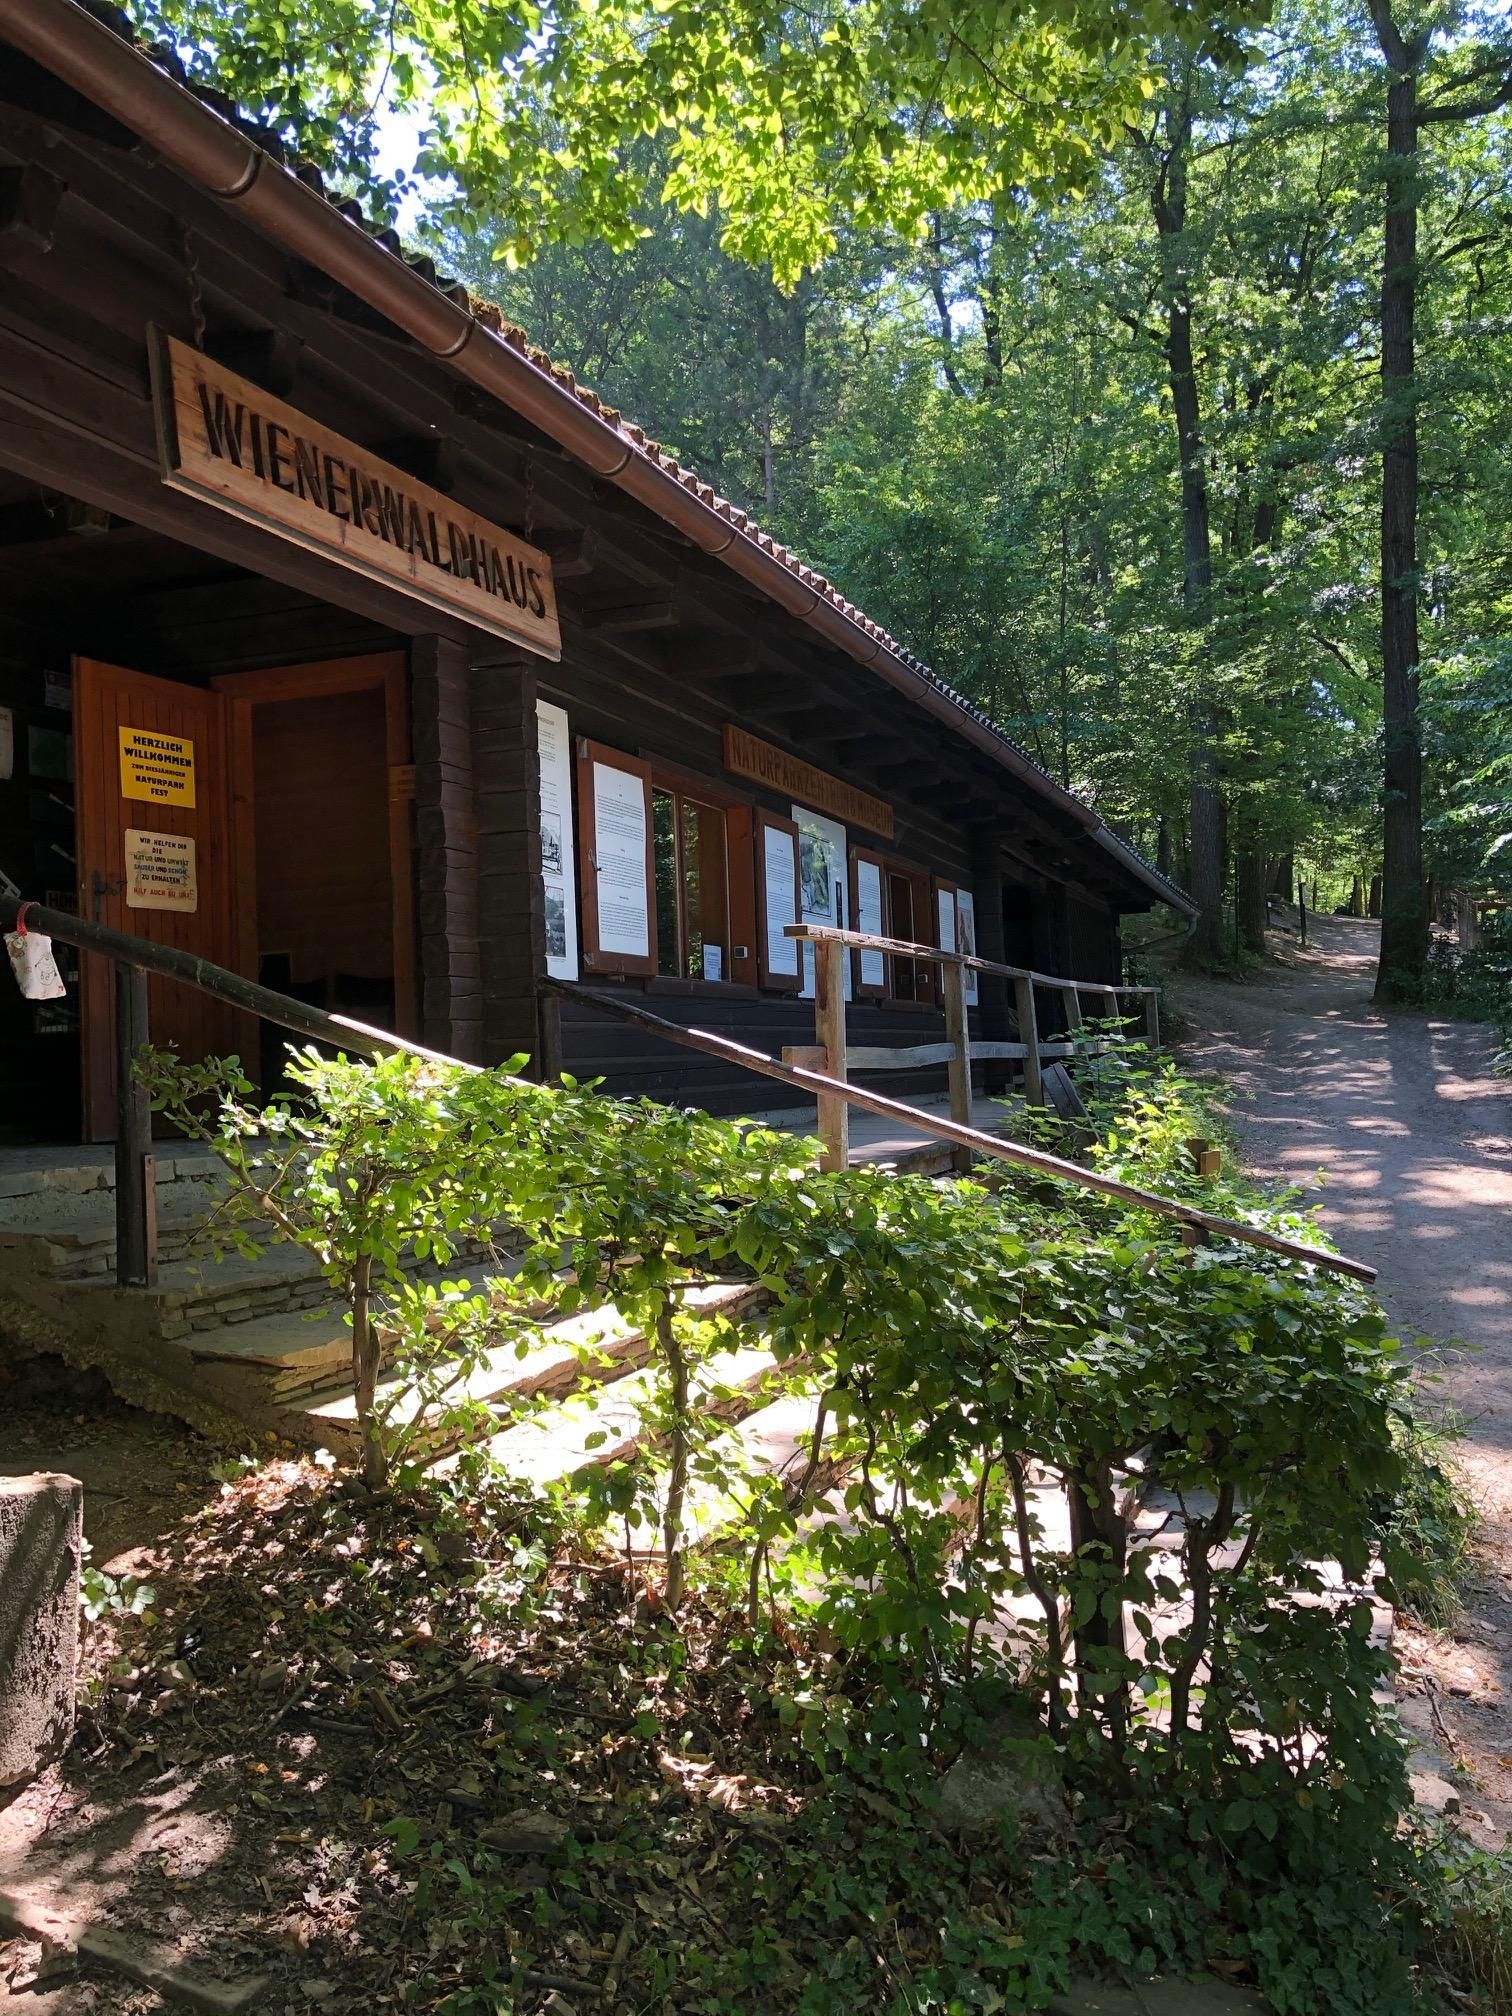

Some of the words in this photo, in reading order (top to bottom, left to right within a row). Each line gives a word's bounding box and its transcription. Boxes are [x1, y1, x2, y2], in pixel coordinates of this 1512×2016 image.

[198, 383, 546, 619] WIENERWALDHAUS
[133, 735, 182, 753] HERZLICH
[124, 747, 192, 768] WILLKOMMEN
[132, 763, 144, 771] ZUM
[135, 775, 185, 790] NATURPARK
[150, 787, 168, 797] FEST
[139, 837, 151, 845] WIR
[153, 840, 177, 849] HELFEN
[151, 875, 181, 884] ERHALTEN
